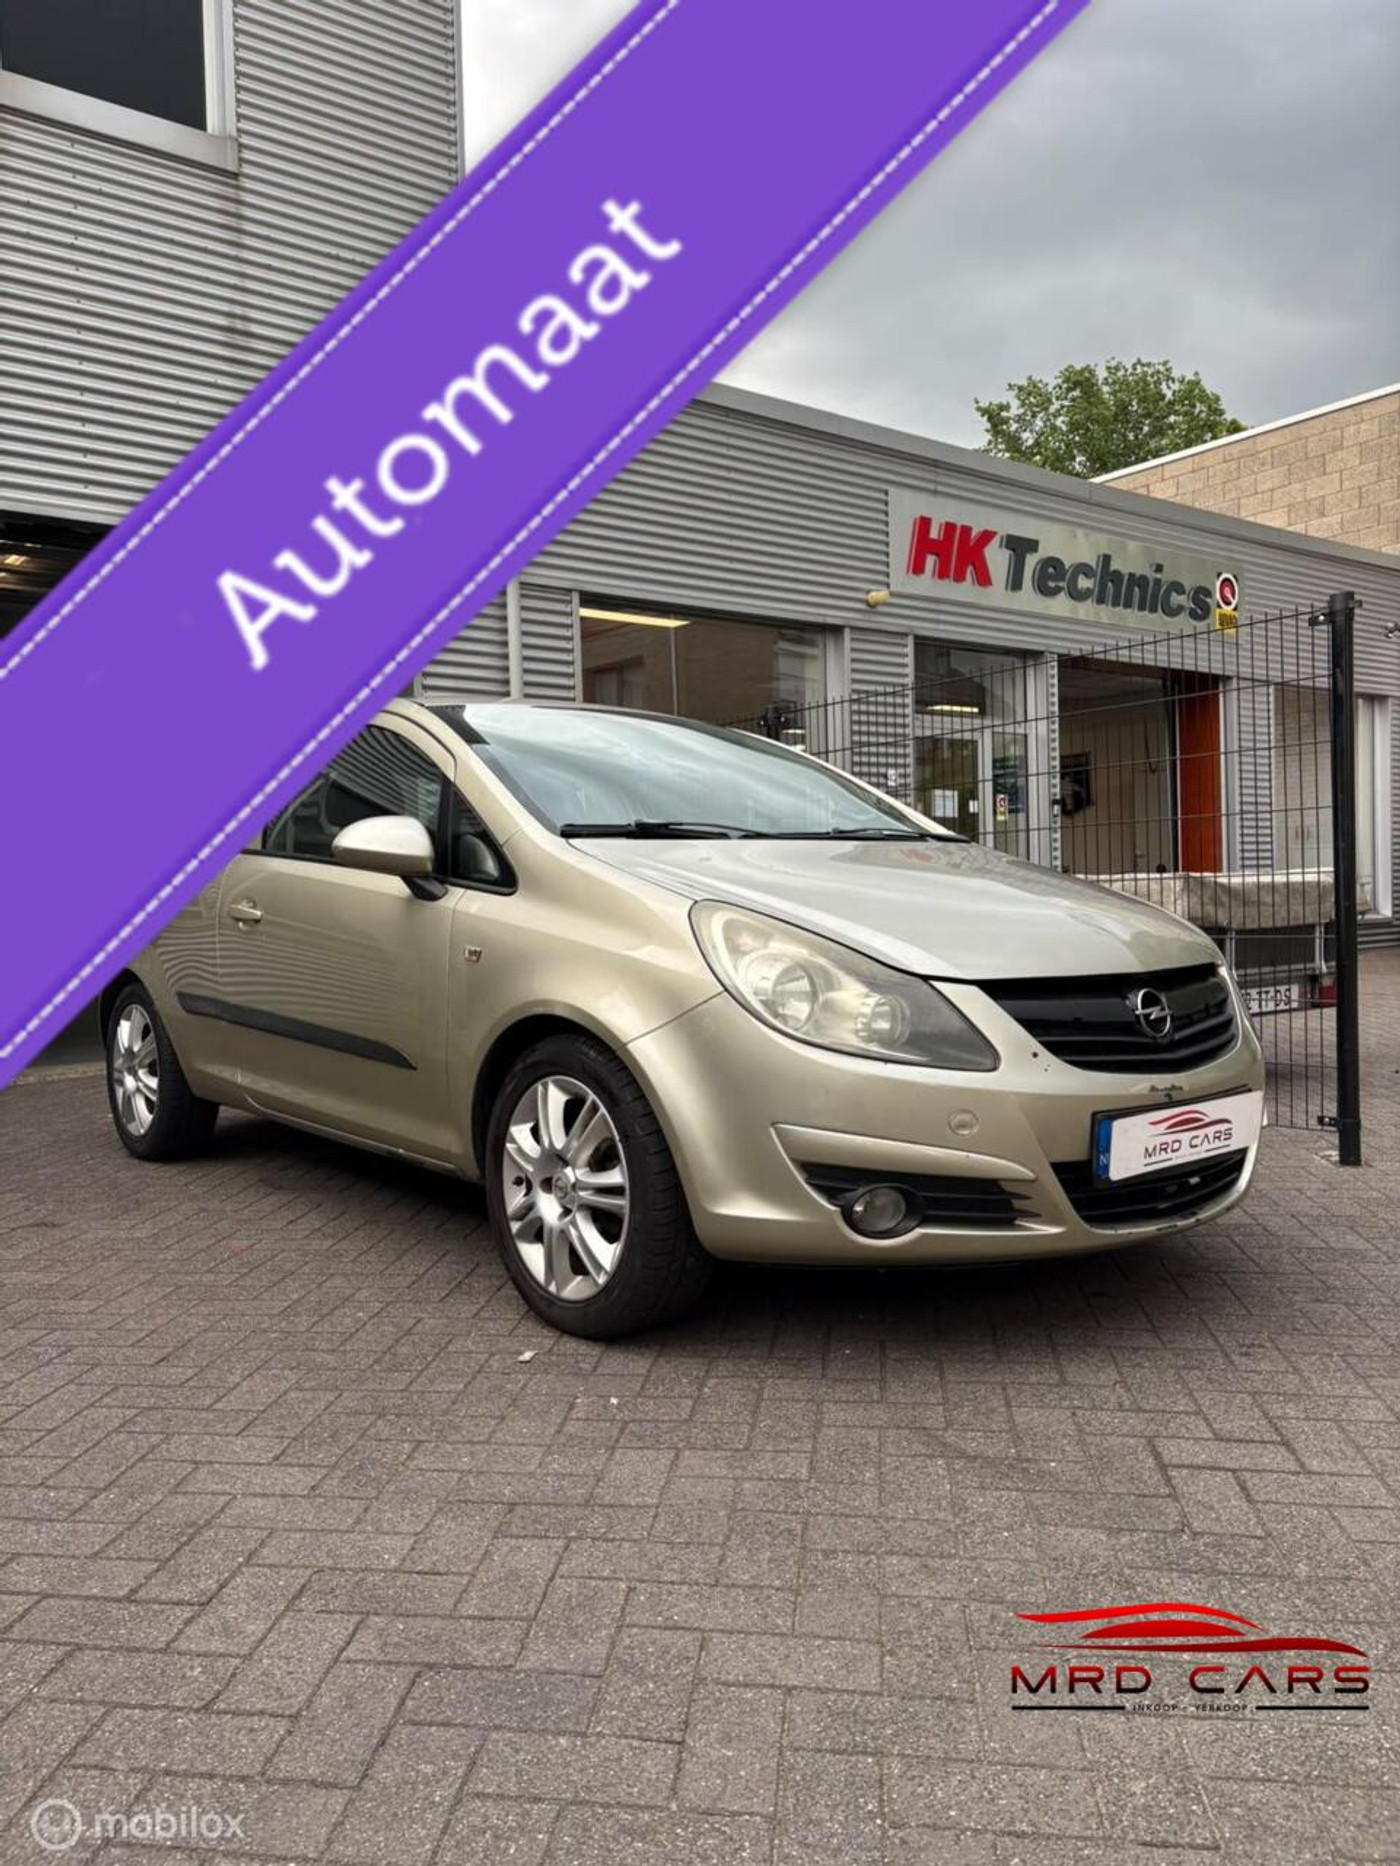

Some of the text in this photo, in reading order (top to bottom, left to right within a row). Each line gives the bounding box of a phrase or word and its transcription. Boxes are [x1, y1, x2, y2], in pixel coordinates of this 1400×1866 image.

[907, 514, 1214, 622] HK Technics
[1143, 1139, 1182, 1159] MRD
[1189, 1127, 1233, 1149] CARS
